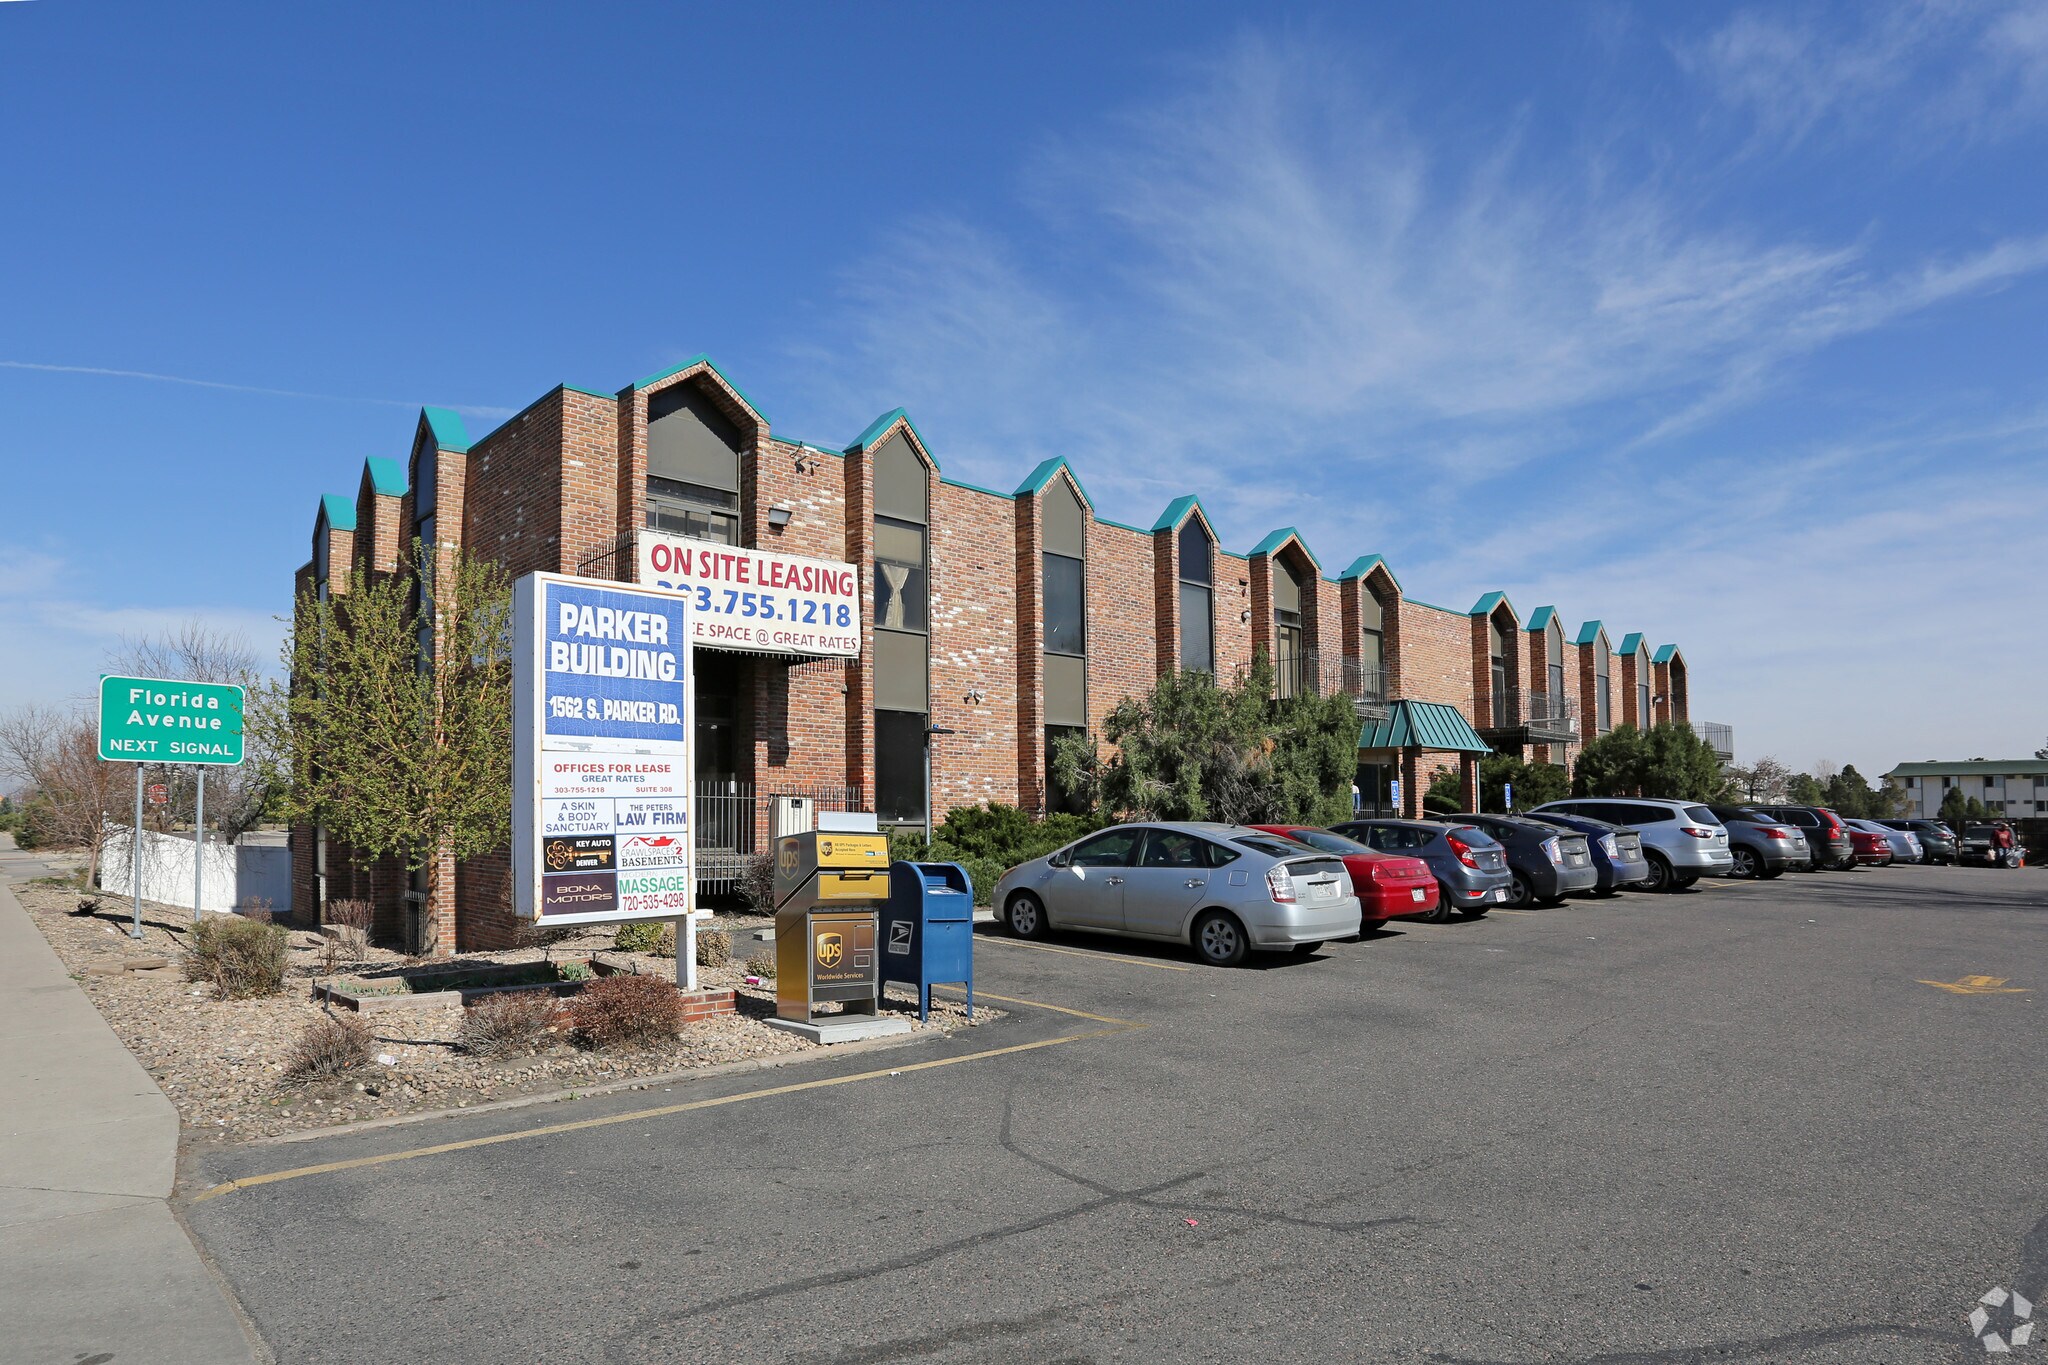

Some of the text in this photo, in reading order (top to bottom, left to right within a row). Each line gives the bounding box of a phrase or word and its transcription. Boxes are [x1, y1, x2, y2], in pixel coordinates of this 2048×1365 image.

[651, 544, 853, 597] ON SITE LEASING
[560, 602, 668, 646] PARKER
[709, 624, 751, 641] SPACE
[755, 629, 770, 646] @
[773, 631, 815, 647] GREAT
[819, 636, 857, 650] RATES
[551, 640, 676, 681] BUILDING
[129, 688, 219, 710] Florida
[550, 695, 682, 725] 1562 S. PARKER RD.
[126, 709, 222, 730] Avenue
[110, 739, 234, 756] NEXT SIGNAL
[554, 763, 671, 773] OFFICES FOR LEASE
[581, 775, 645, 783] GREAT RATES
[560, 802, 595, 811] A SKIN
[557, 812, 598, 822] & BODY
[616, 812, 687, 826] LAW FIRM
[545, 822, 610, 832] SANCTUARY
[576, 839, 612, 848] KEY AUTO
[620, 846, 683, 858] CRAWLSPACES 2
[576, 859, 598, 867] DENVER
[621, 856, 684, 868] BASEMENTS
[556, 884, 602, 894] BONA
[619, 876, 684, 894] MASSAGE
[546, 892, 613, 904] MOTORS
[622, 892, 684, 911] 720-535-4298
[819, 943, 841, 963] ups
